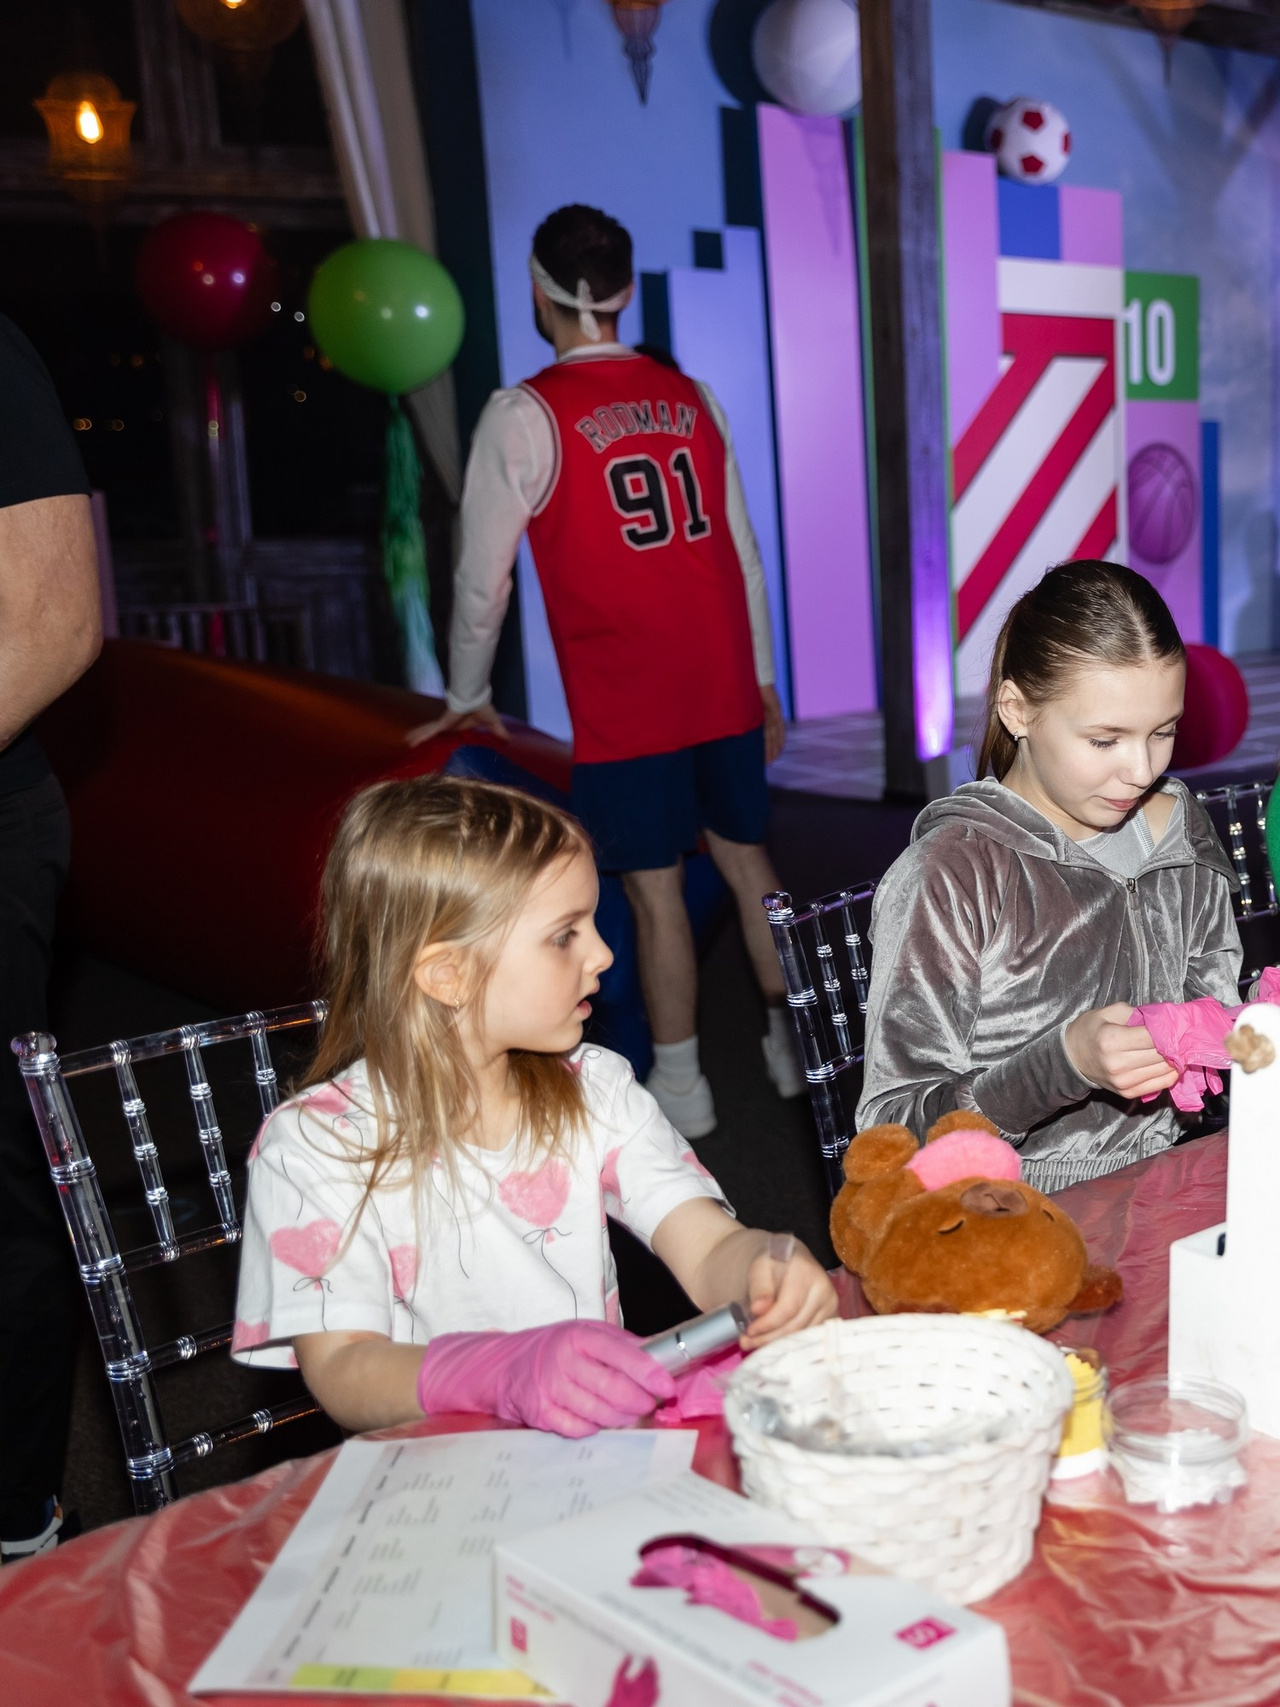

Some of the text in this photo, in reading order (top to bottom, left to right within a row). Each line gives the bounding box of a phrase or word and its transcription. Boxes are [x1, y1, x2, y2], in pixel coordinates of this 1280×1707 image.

[1122, 298, 1177, 386] 10
[574, 399, 698, 454] RODMAN
[603, 446, 712, 552] 91
